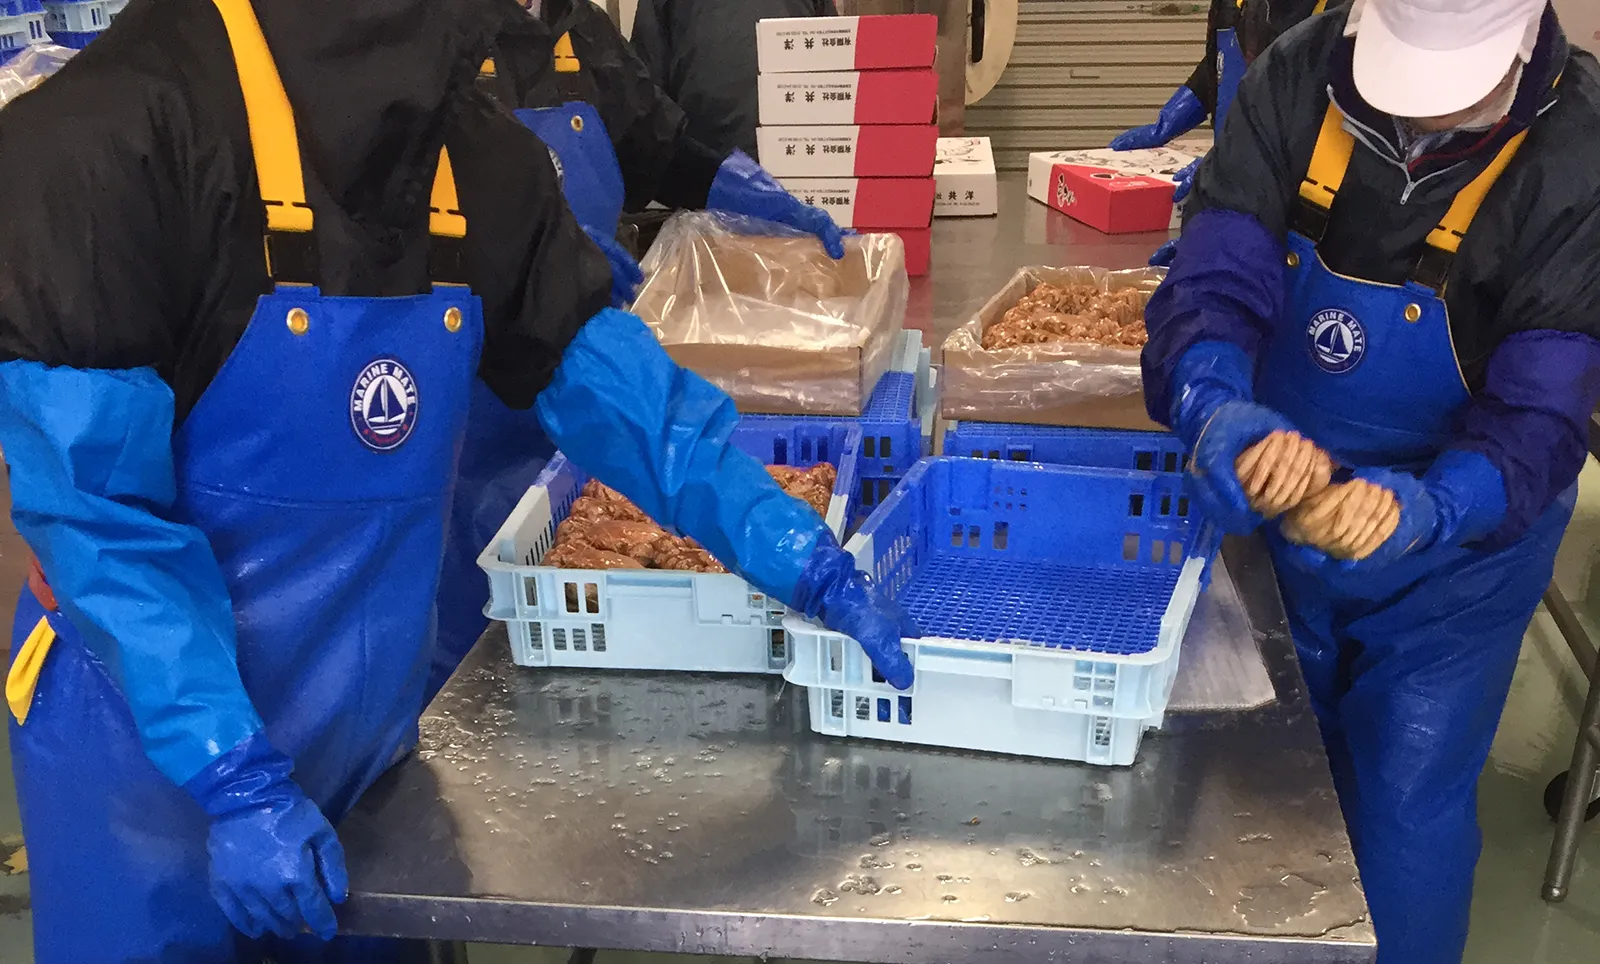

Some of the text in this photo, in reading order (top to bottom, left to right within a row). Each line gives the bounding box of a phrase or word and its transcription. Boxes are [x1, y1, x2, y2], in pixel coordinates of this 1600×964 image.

[784, 37, 852, 50] 有限会社 共 洋
[784, 91, 852, 103] 有限会社 共 洋
[785, 144, 852, 155] 有限会社 共 洋
[821, 195, 850, 205] 有限会社
[1308, 311, 1363, 352] MARINE MATE
[353, 363, 416, 412] MARINE MATE
